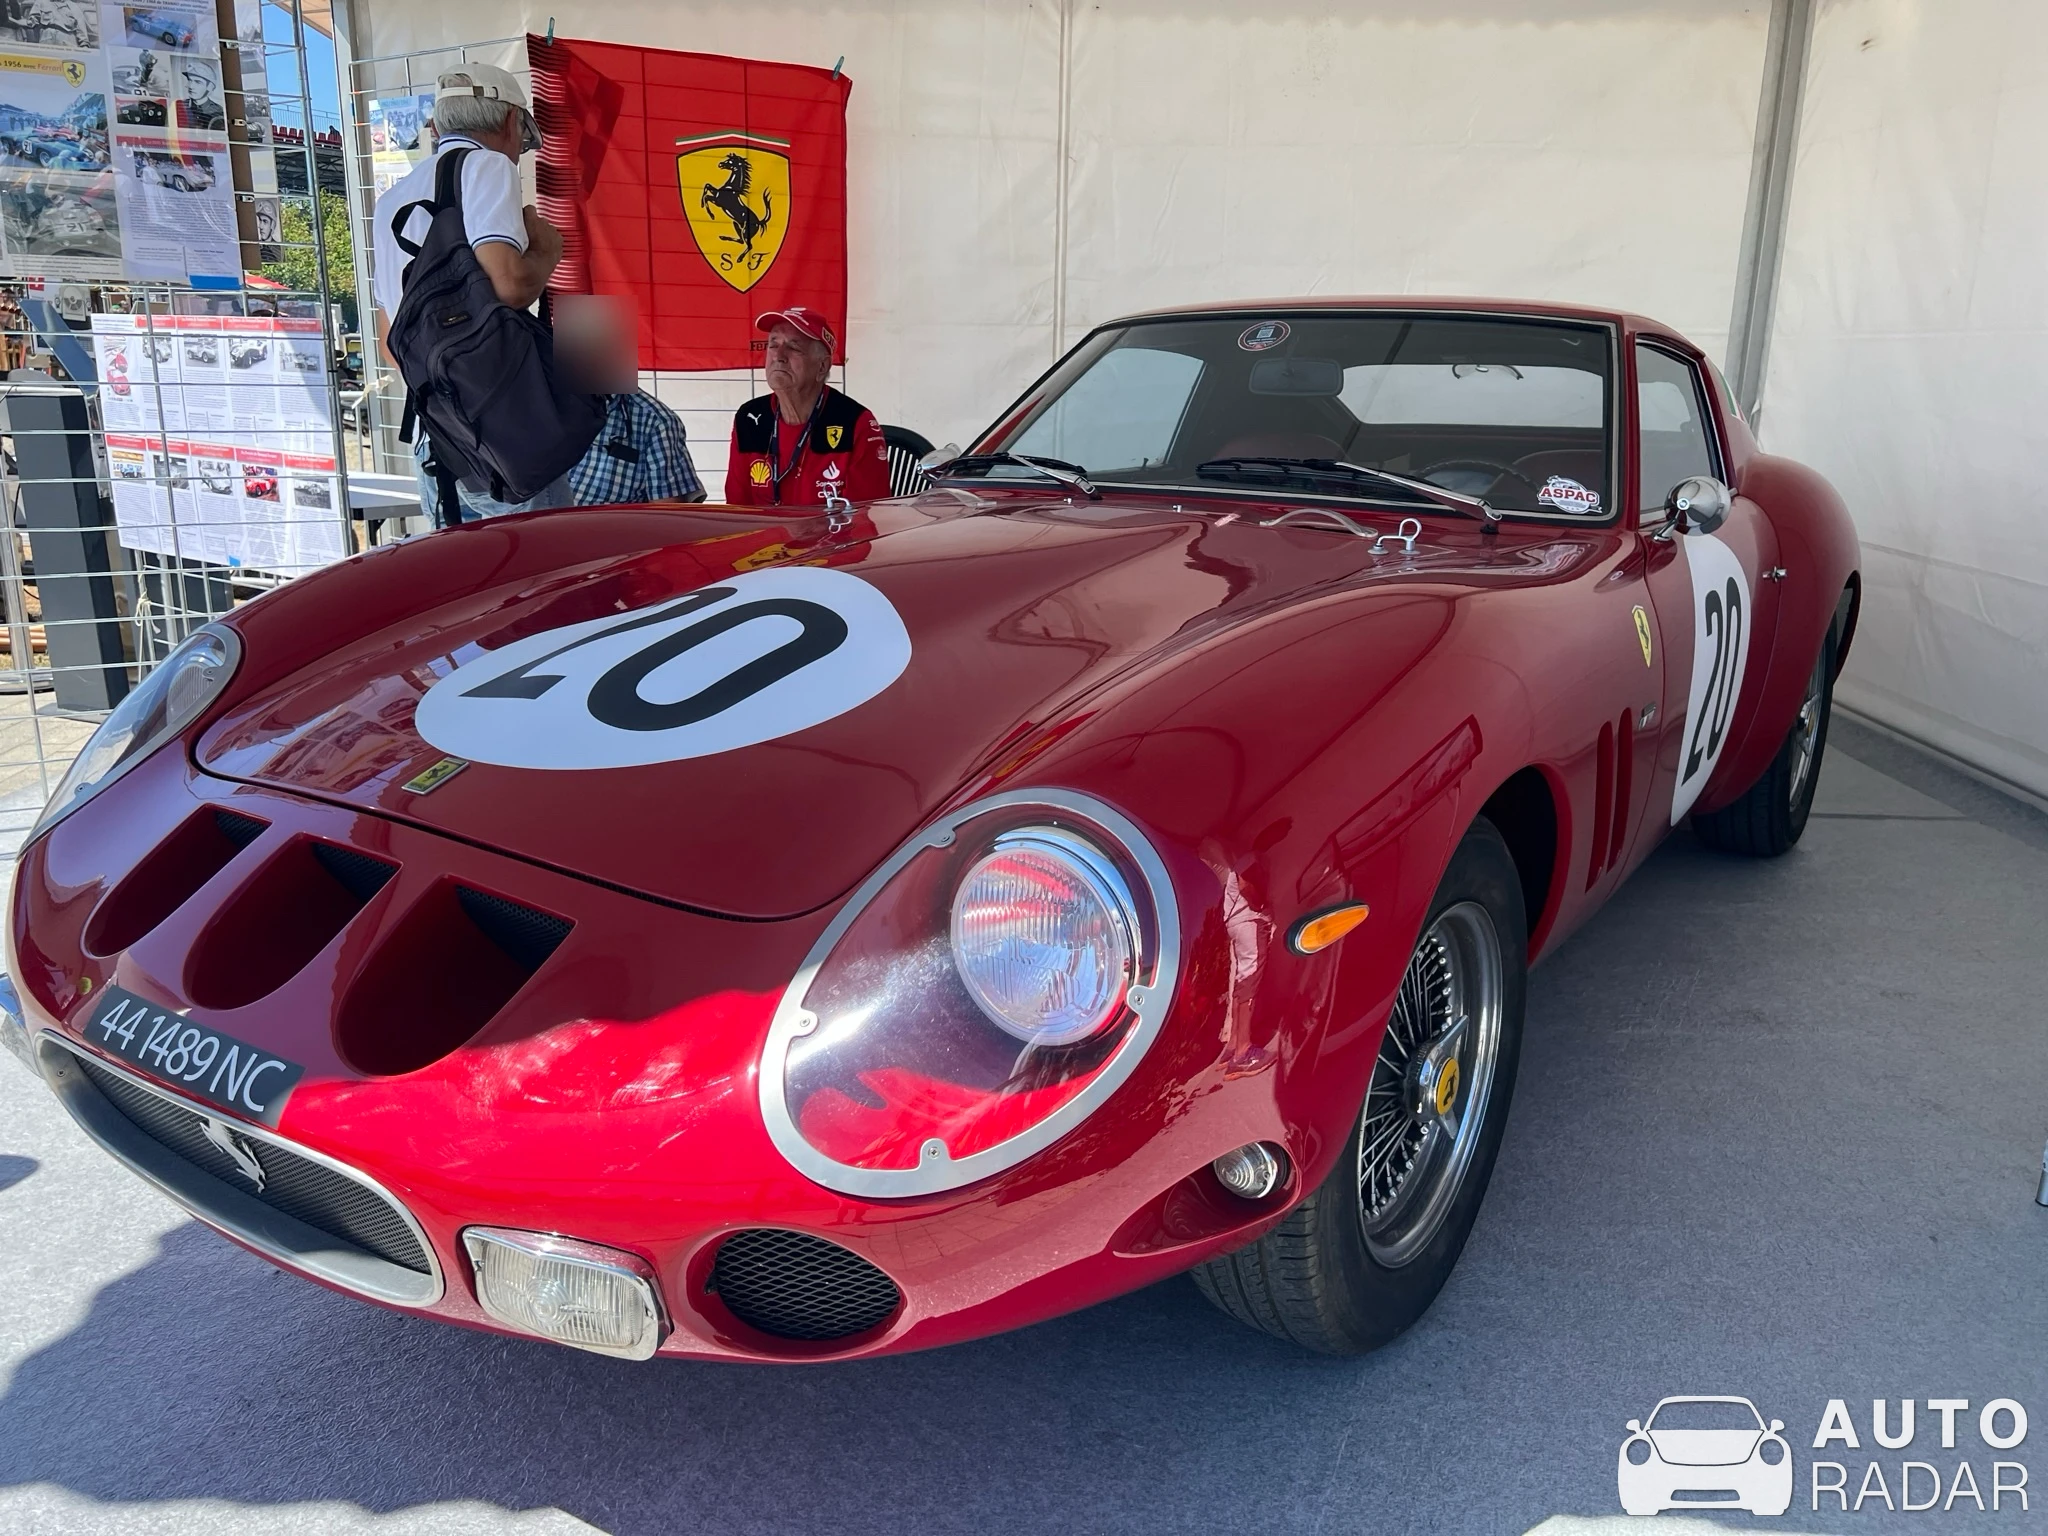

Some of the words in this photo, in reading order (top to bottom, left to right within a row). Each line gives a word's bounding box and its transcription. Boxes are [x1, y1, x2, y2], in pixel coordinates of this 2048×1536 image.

[4, 60, 22, 68] 1956
[37, 63, 62, 73] Ferrari
[24, 140, 32, 152] 21
[66, 222, 84, 232] 21
[720, 253, 734, 271] S
[1540, 487, 1596, 503] ASPAC
[457, 586, 849, 732] 20
[1681, 576, 1742, 787] 20
[100, 998, 149, 1051] 44
[138, 1015, 220, 1082] 1489
[209, 1044, 287, 1113] NC
